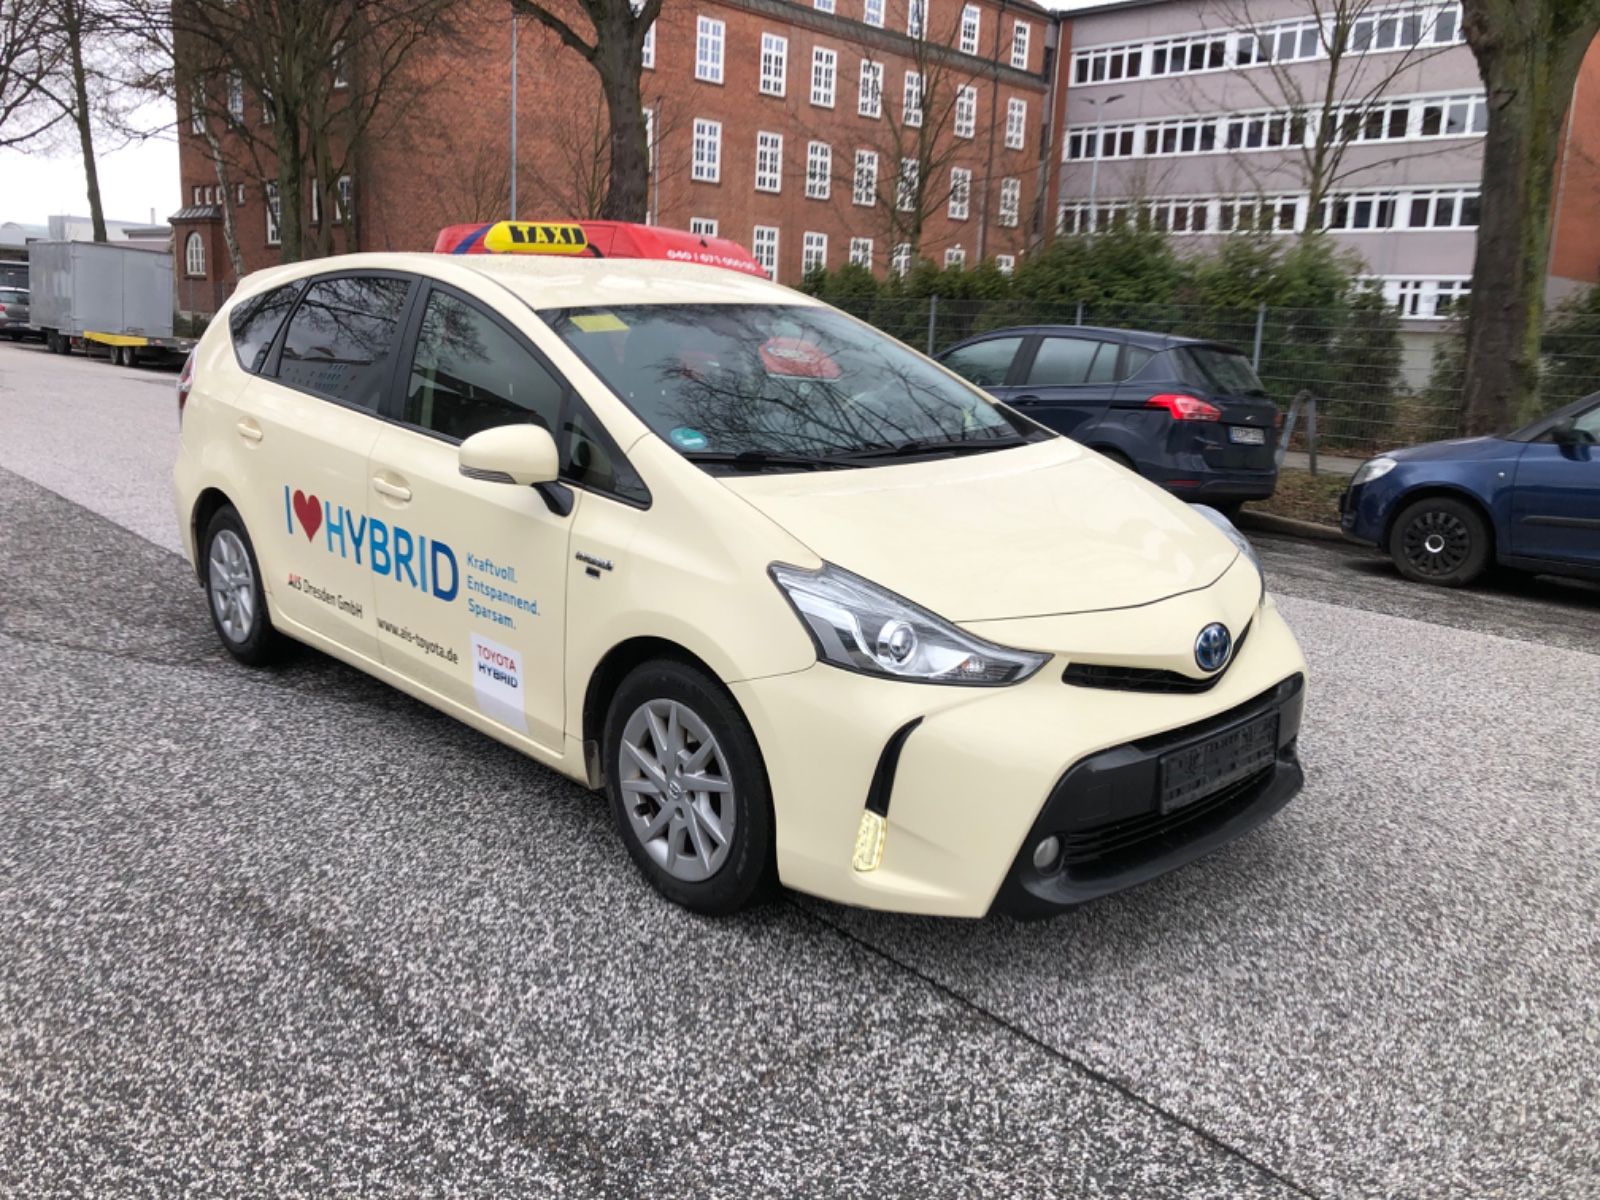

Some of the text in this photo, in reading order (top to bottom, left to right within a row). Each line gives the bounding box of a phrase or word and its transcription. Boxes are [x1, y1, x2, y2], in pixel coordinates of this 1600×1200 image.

[508, 225, 585, 244] TAXI
[325, 501, 459, 602] HYBRID
[467, 552, 518, 583] Kraftvoll.
[303, 578, 336, 606] Dresden
[337, 594, 363, 619] GmbH
[466, 575, 540, 617] Entspannend.
[468, 598, 516, 630] Sparsam.
[376, 617, 458, 664] www.ais-toyota.de
[477, 644, 516, 672] TOYOTA
[478, 662, 519, 688] HYBRID
